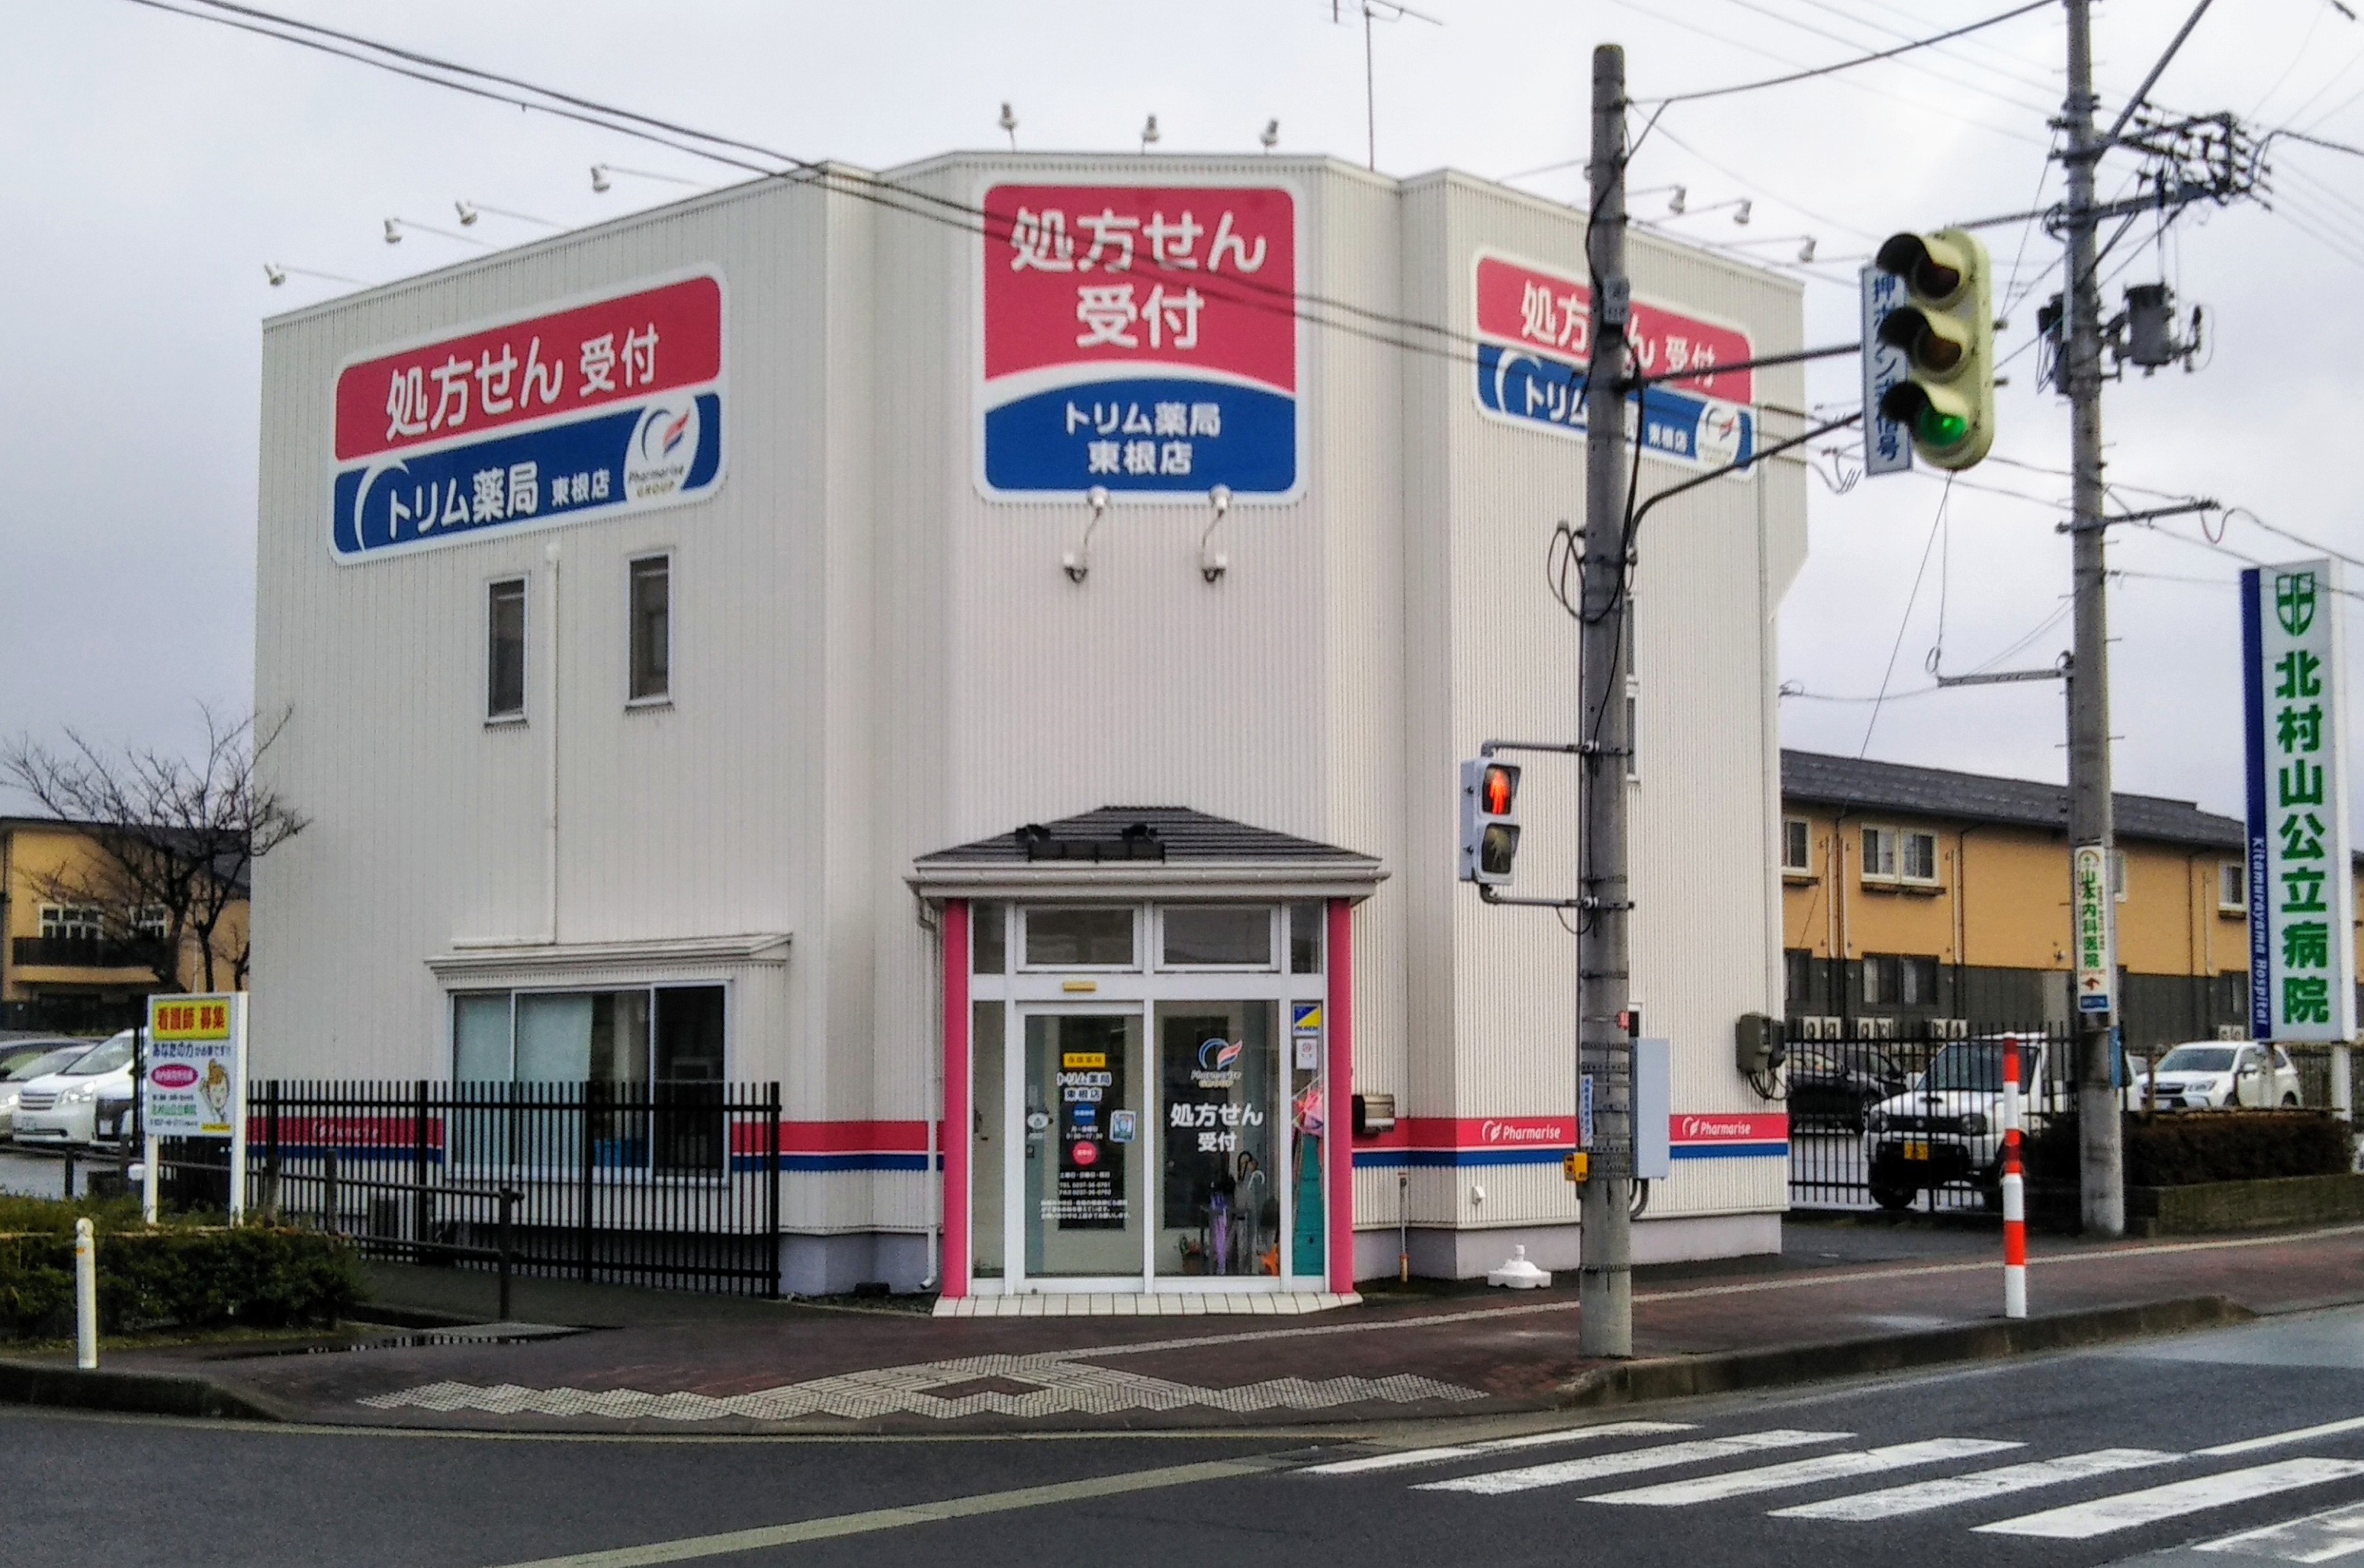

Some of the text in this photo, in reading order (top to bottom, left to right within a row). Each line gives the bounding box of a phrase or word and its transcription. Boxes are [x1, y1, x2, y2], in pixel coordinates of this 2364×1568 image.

[1010, 206, 1267, 273] 処方せん
[1076, 284, 1205, 350] 受付
[1521, 279, 1656, 379] 処方ん
[386, 323, 659, 442] 処方せん 受付
[1067, 400, 1222, 437] トリム薬局
[1087, 440, 1193, 475] 東根店
[388, 462, 611, 540] トリム薬局 東根店
[2275, 649, 2330, 1025] 北村山公立病院
[2256, 958, 2269, 1026] Hospital
[1171, 1103, 1264, 1127] 処方せん
[1197, 1131, 1237, 1152] 受付
[1502, 1123, 1561, 1141] Pharmarise
[1700, 1120, 1752, 1136] Pharmarise
